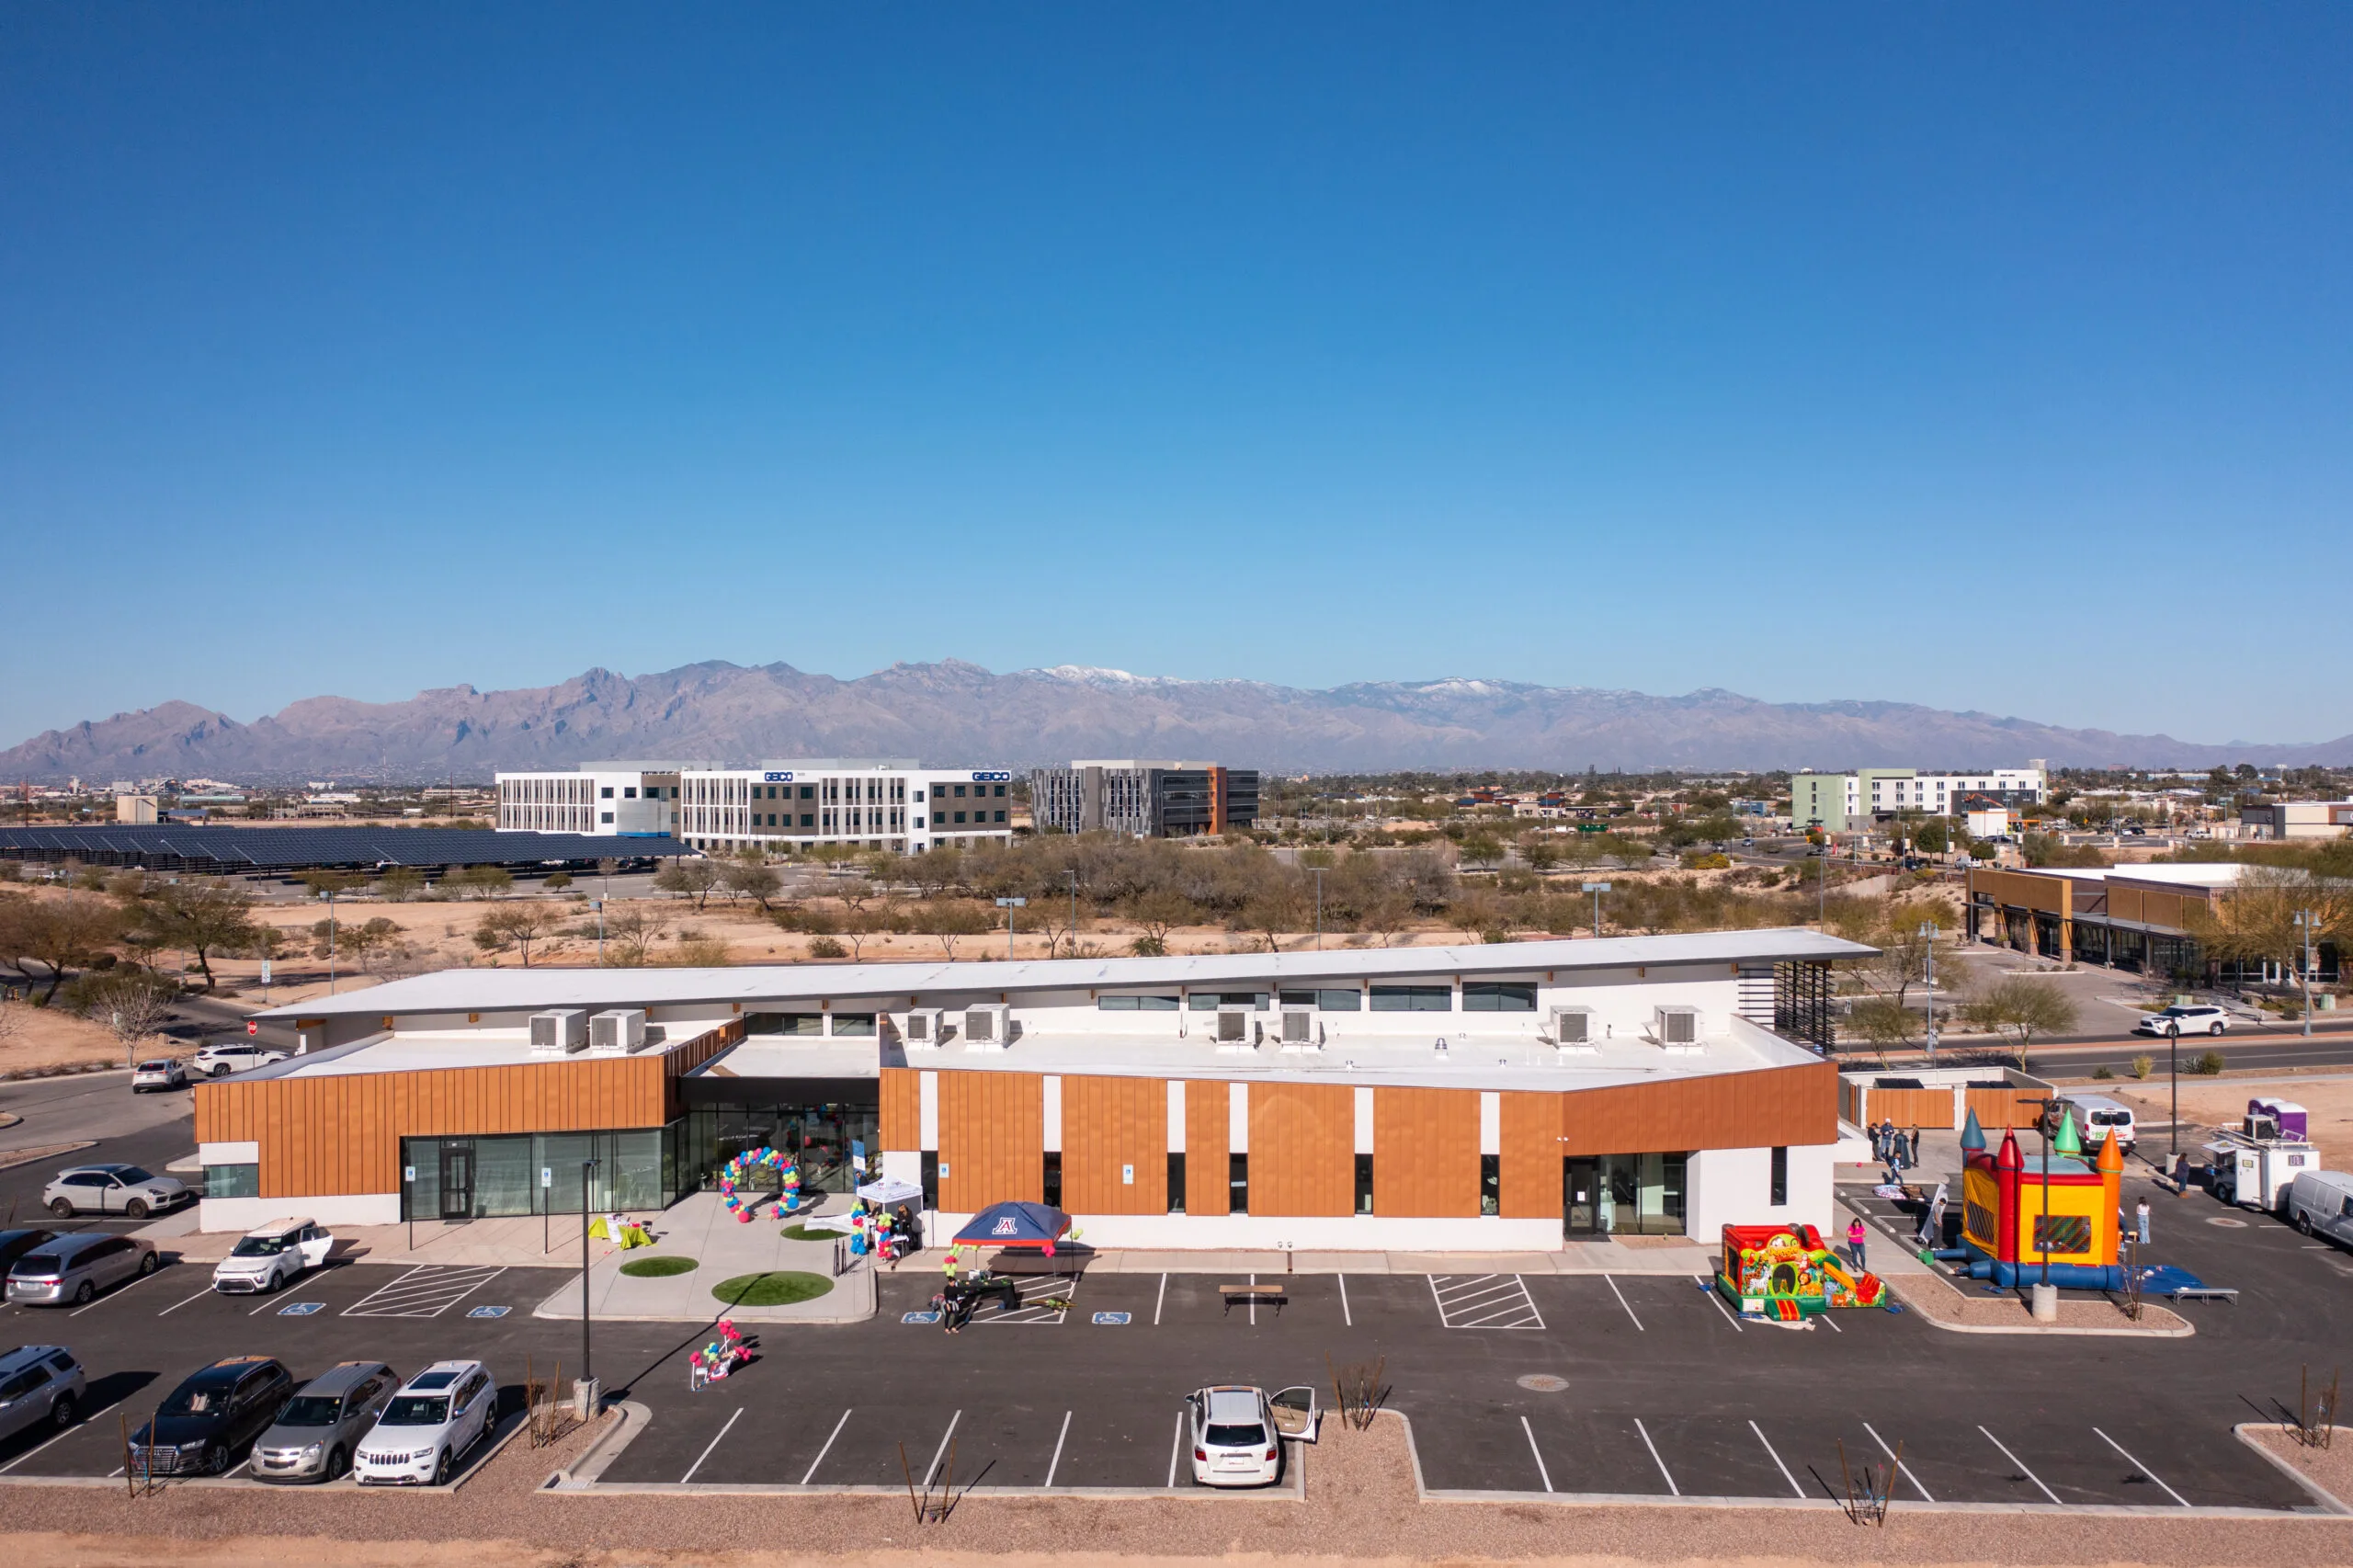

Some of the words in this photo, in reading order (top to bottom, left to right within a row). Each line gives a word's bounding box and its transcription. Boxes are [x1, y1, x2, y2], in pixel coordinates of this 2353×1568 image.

[765, 772, 793, 781] GEICO
[972, 772, 1010, 781] GEICO
[992, 1217, 1017, 1234] A
